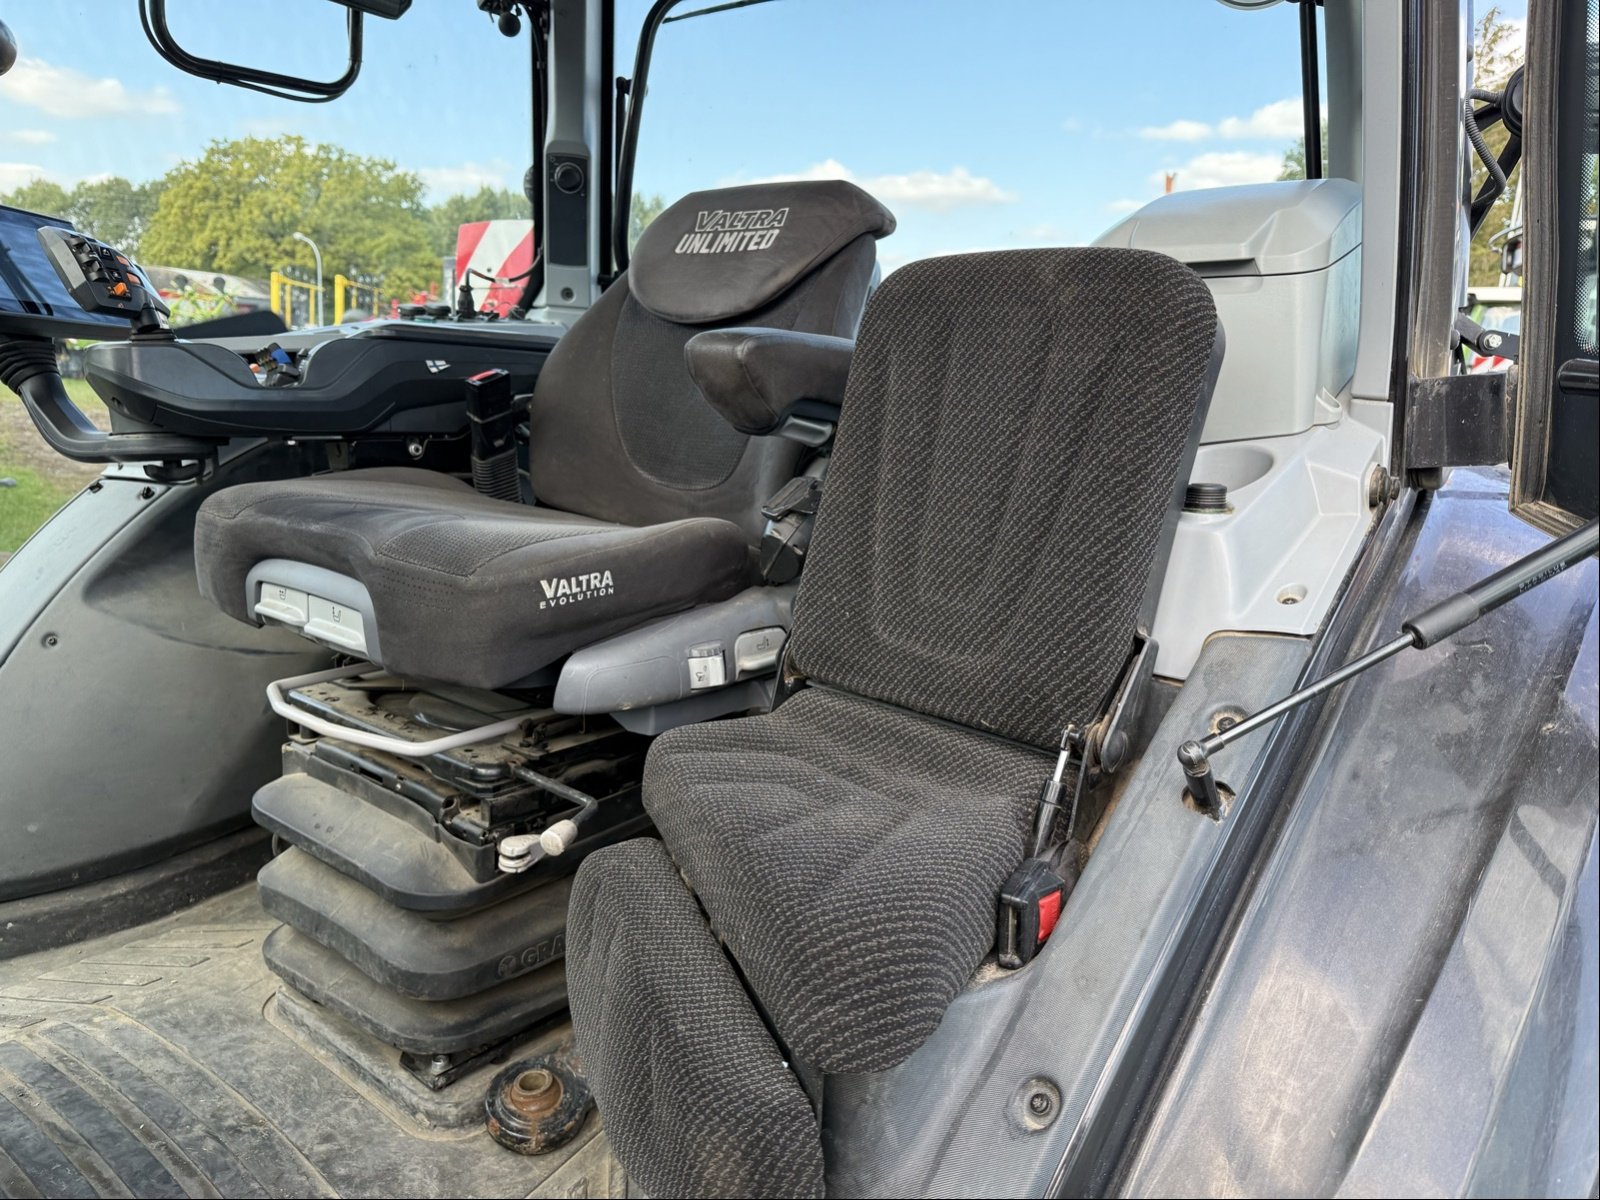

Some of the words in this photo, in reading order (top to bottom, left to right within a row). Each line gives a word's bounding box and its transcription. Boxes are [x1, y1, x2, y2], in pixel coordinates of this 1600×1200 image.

[695, 207, 790, 232] VALTRA
[675, 229, 780, 254] UNLIMITED
[540, 570, 614, 599] VALTRA
[540, 587, 614, 609] EVOLUTION
